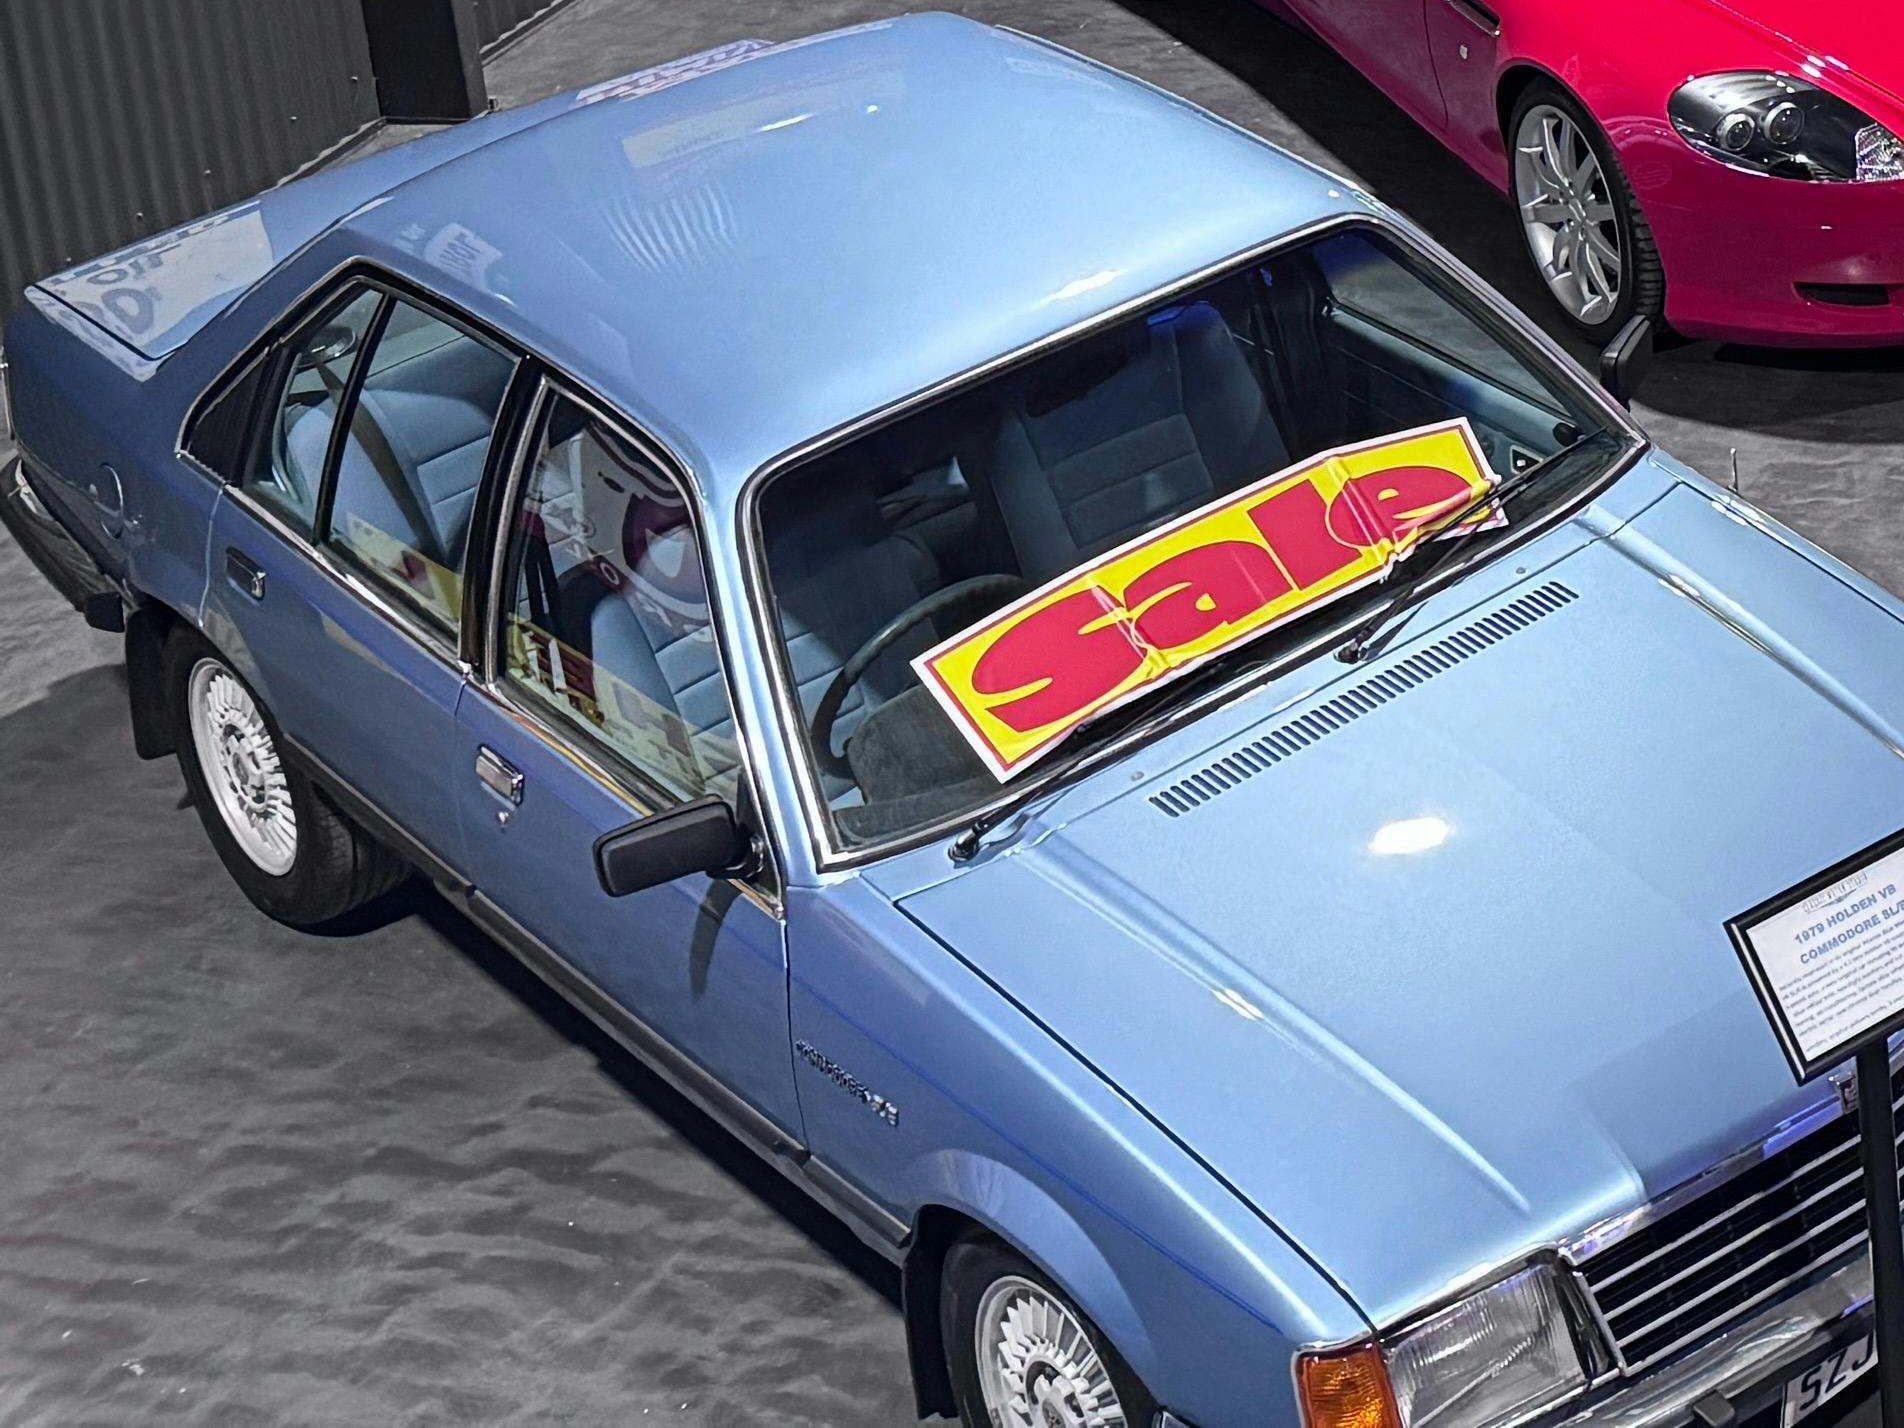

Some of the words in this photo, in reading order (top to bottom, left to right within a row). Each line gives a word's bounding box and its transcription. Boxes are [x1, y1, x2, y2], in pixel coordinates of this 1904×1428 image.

[971, 464, 1475, 733] Sale
[1794, 922, 1825, 945] 1979
[1826, 893, 1878, 929] HOLDEN
[1878, 883, 1898, 903] VB
[1799, 914, 1882, 965] COMMODORE
